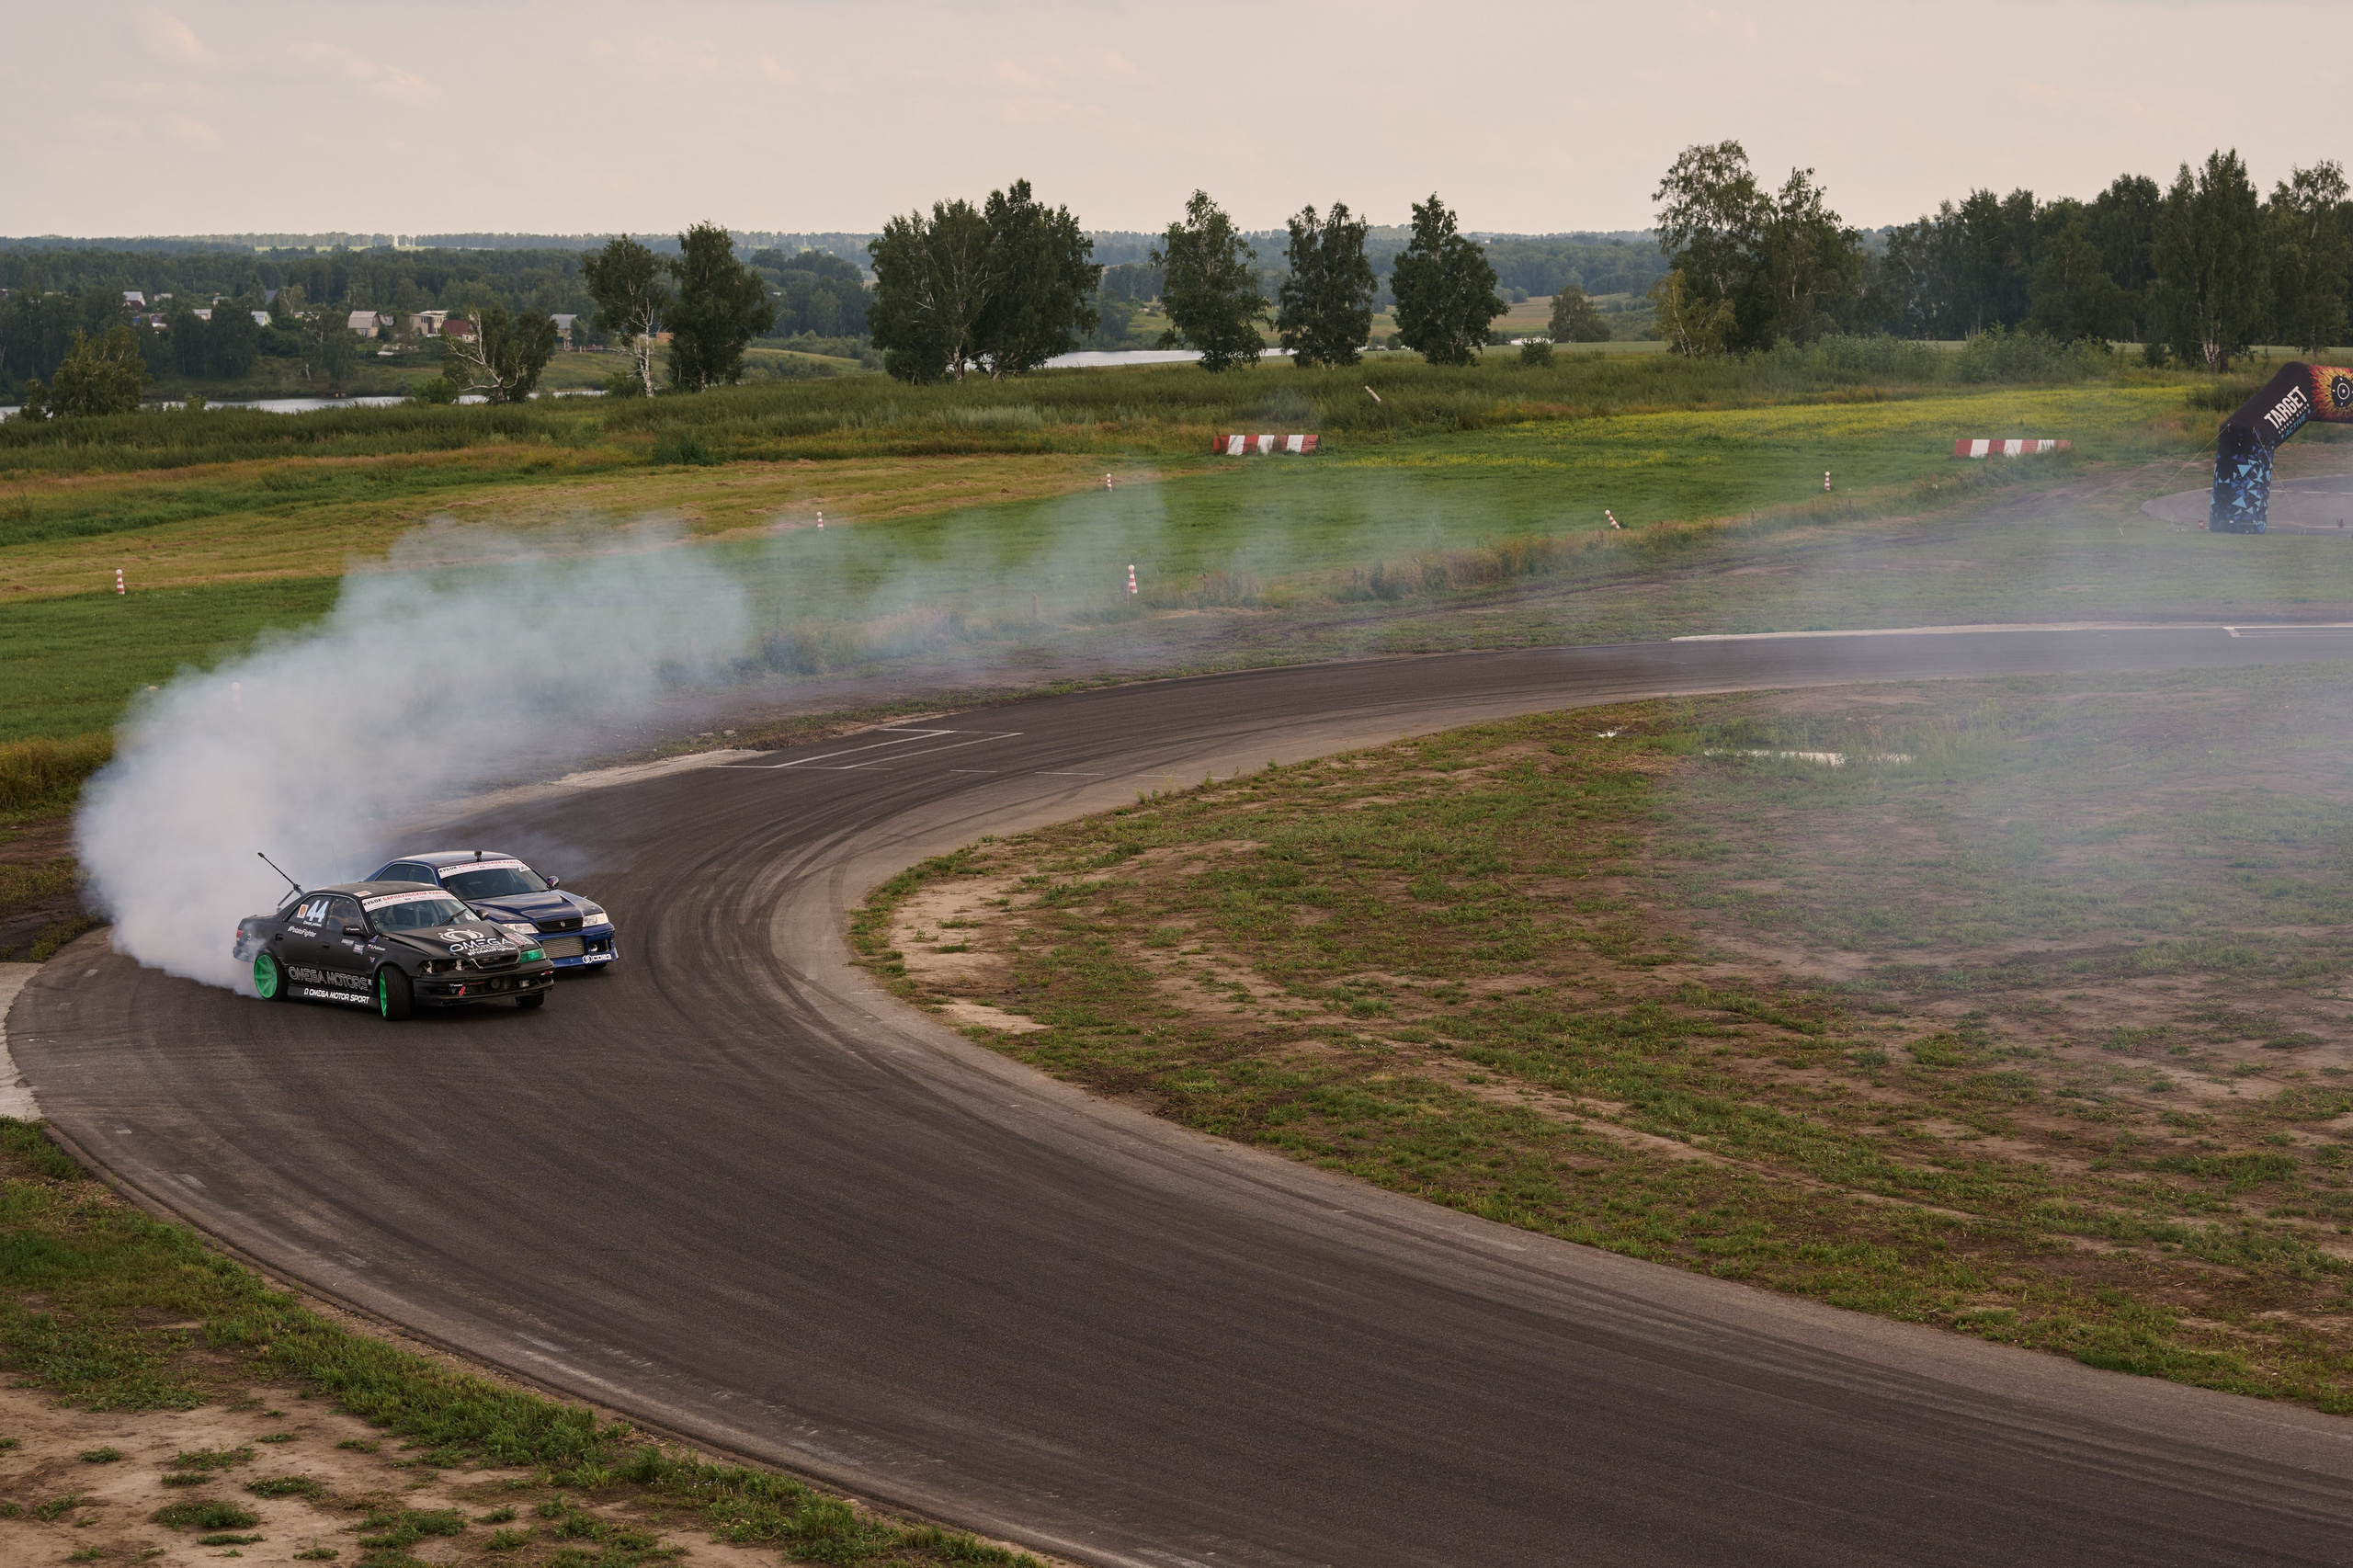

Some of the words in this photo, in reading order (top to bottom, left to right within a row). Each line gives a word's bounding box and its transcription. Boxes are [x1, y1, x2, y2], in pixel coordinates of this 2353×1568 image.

[2263, 386, 2308, 429] TARGET
[2285, 413, 2306, 437] ACTIVE
[306, 900, 330, 923] 44
[364, 898, 382, 906] КУБОК
[287, 926, 317, 937] #PotatoFighter
[449, 937, 514, 953] OMEGA
[288, 966, 327, 984] OMEGA
[327, 971, 369, 991] MOTORS
[309, 988, 329, 998] OMEGA
[330, 991, 349, 1001] MOTOR
[350, 994, 370, 1004] SPORT
